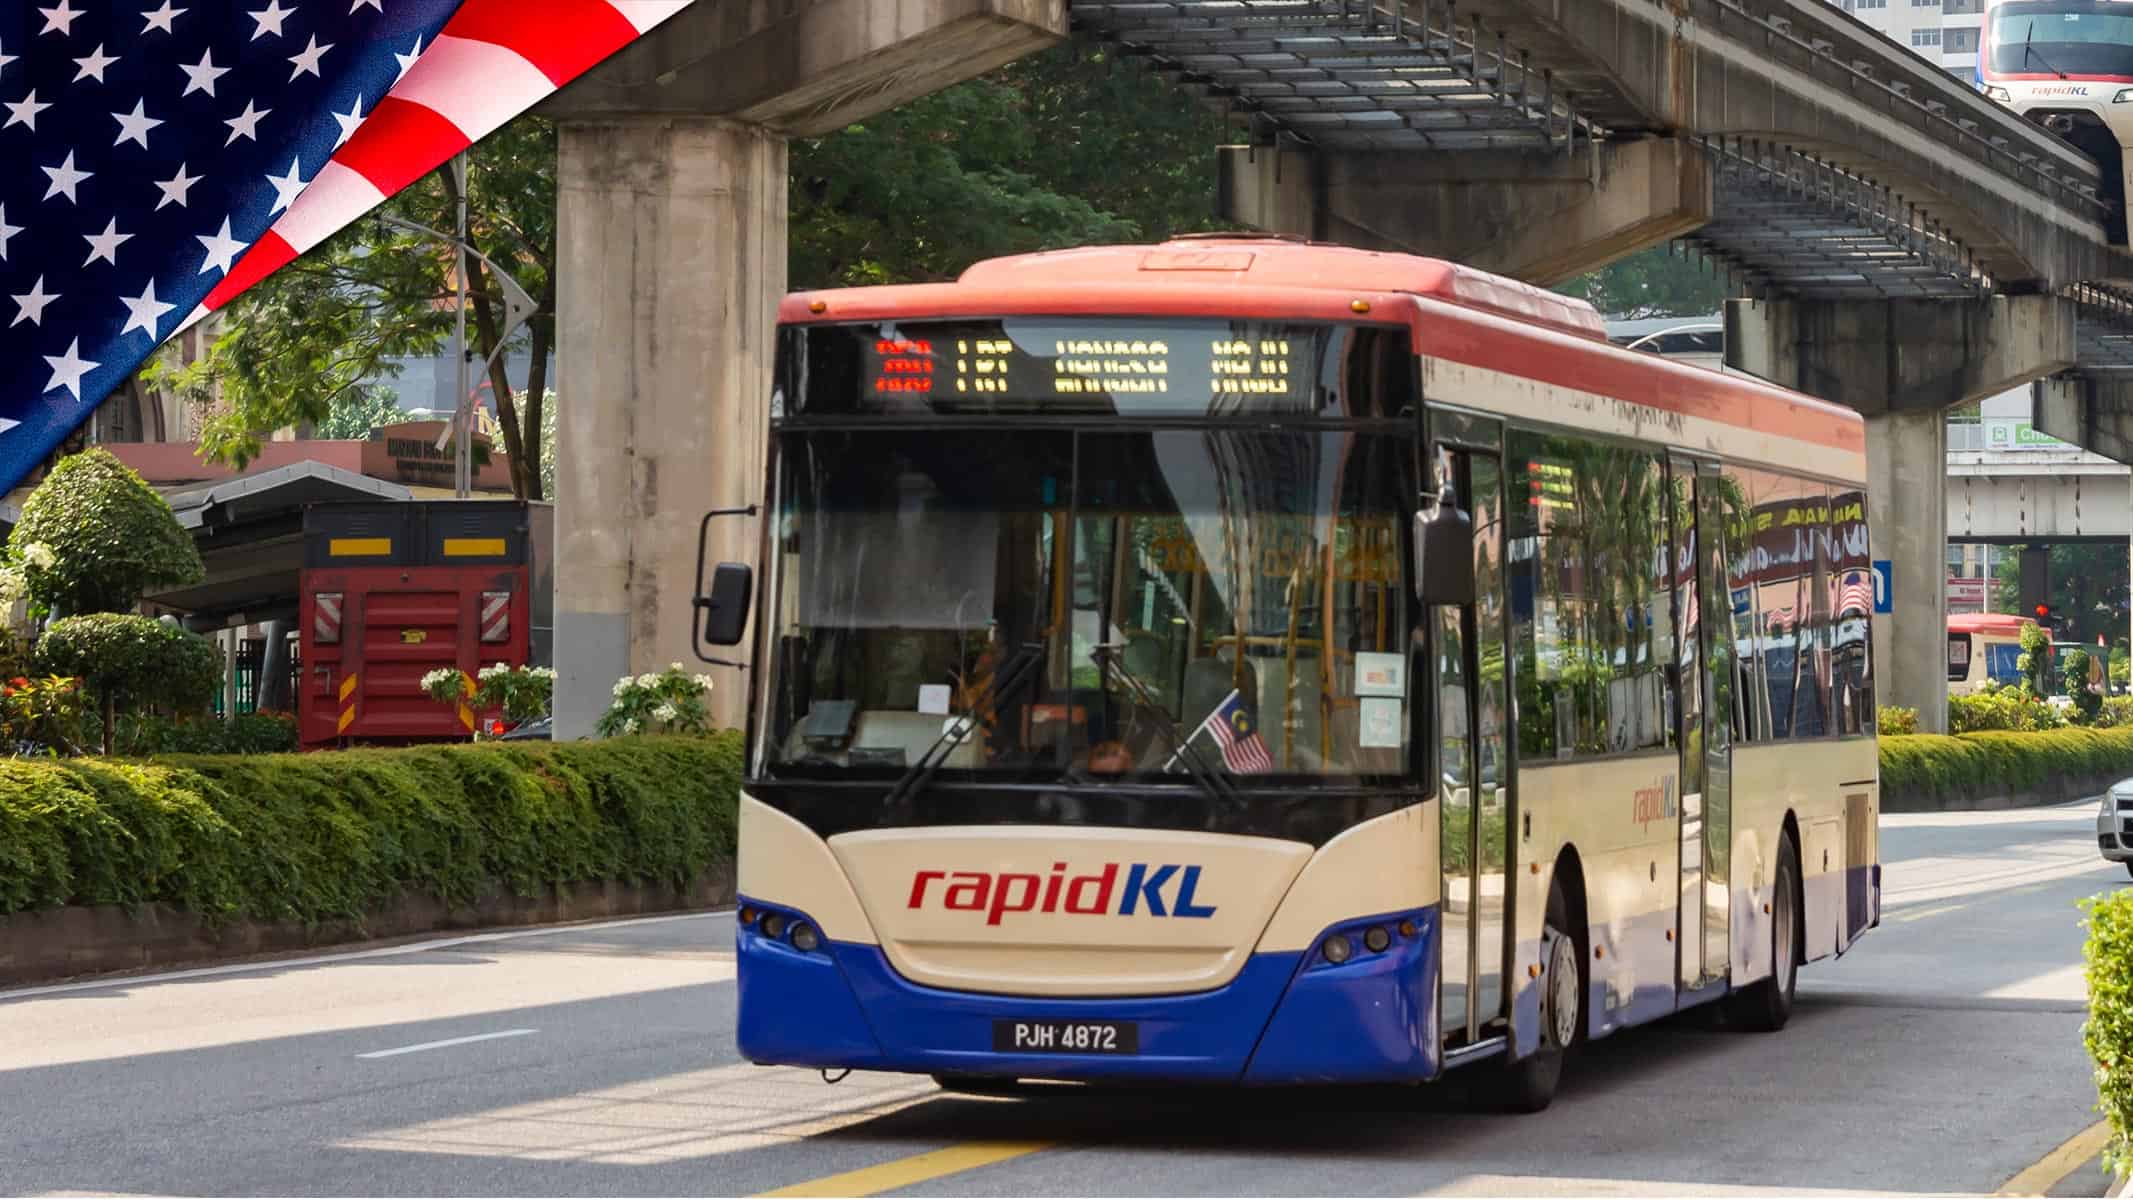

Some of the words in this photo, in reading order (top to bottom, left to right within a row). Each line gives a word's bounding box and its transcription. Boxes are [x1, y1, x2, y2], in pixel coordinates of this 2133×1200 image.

[2031, 85, 2089, 97] rapidKL
[1632, 775, 1676, 833] rapidKL
[907, 862, 1217, 926] rapidKL
[1015, 1023, 1053, 1048] PJH
[1061, 1024, 1117, 1049] 4872
